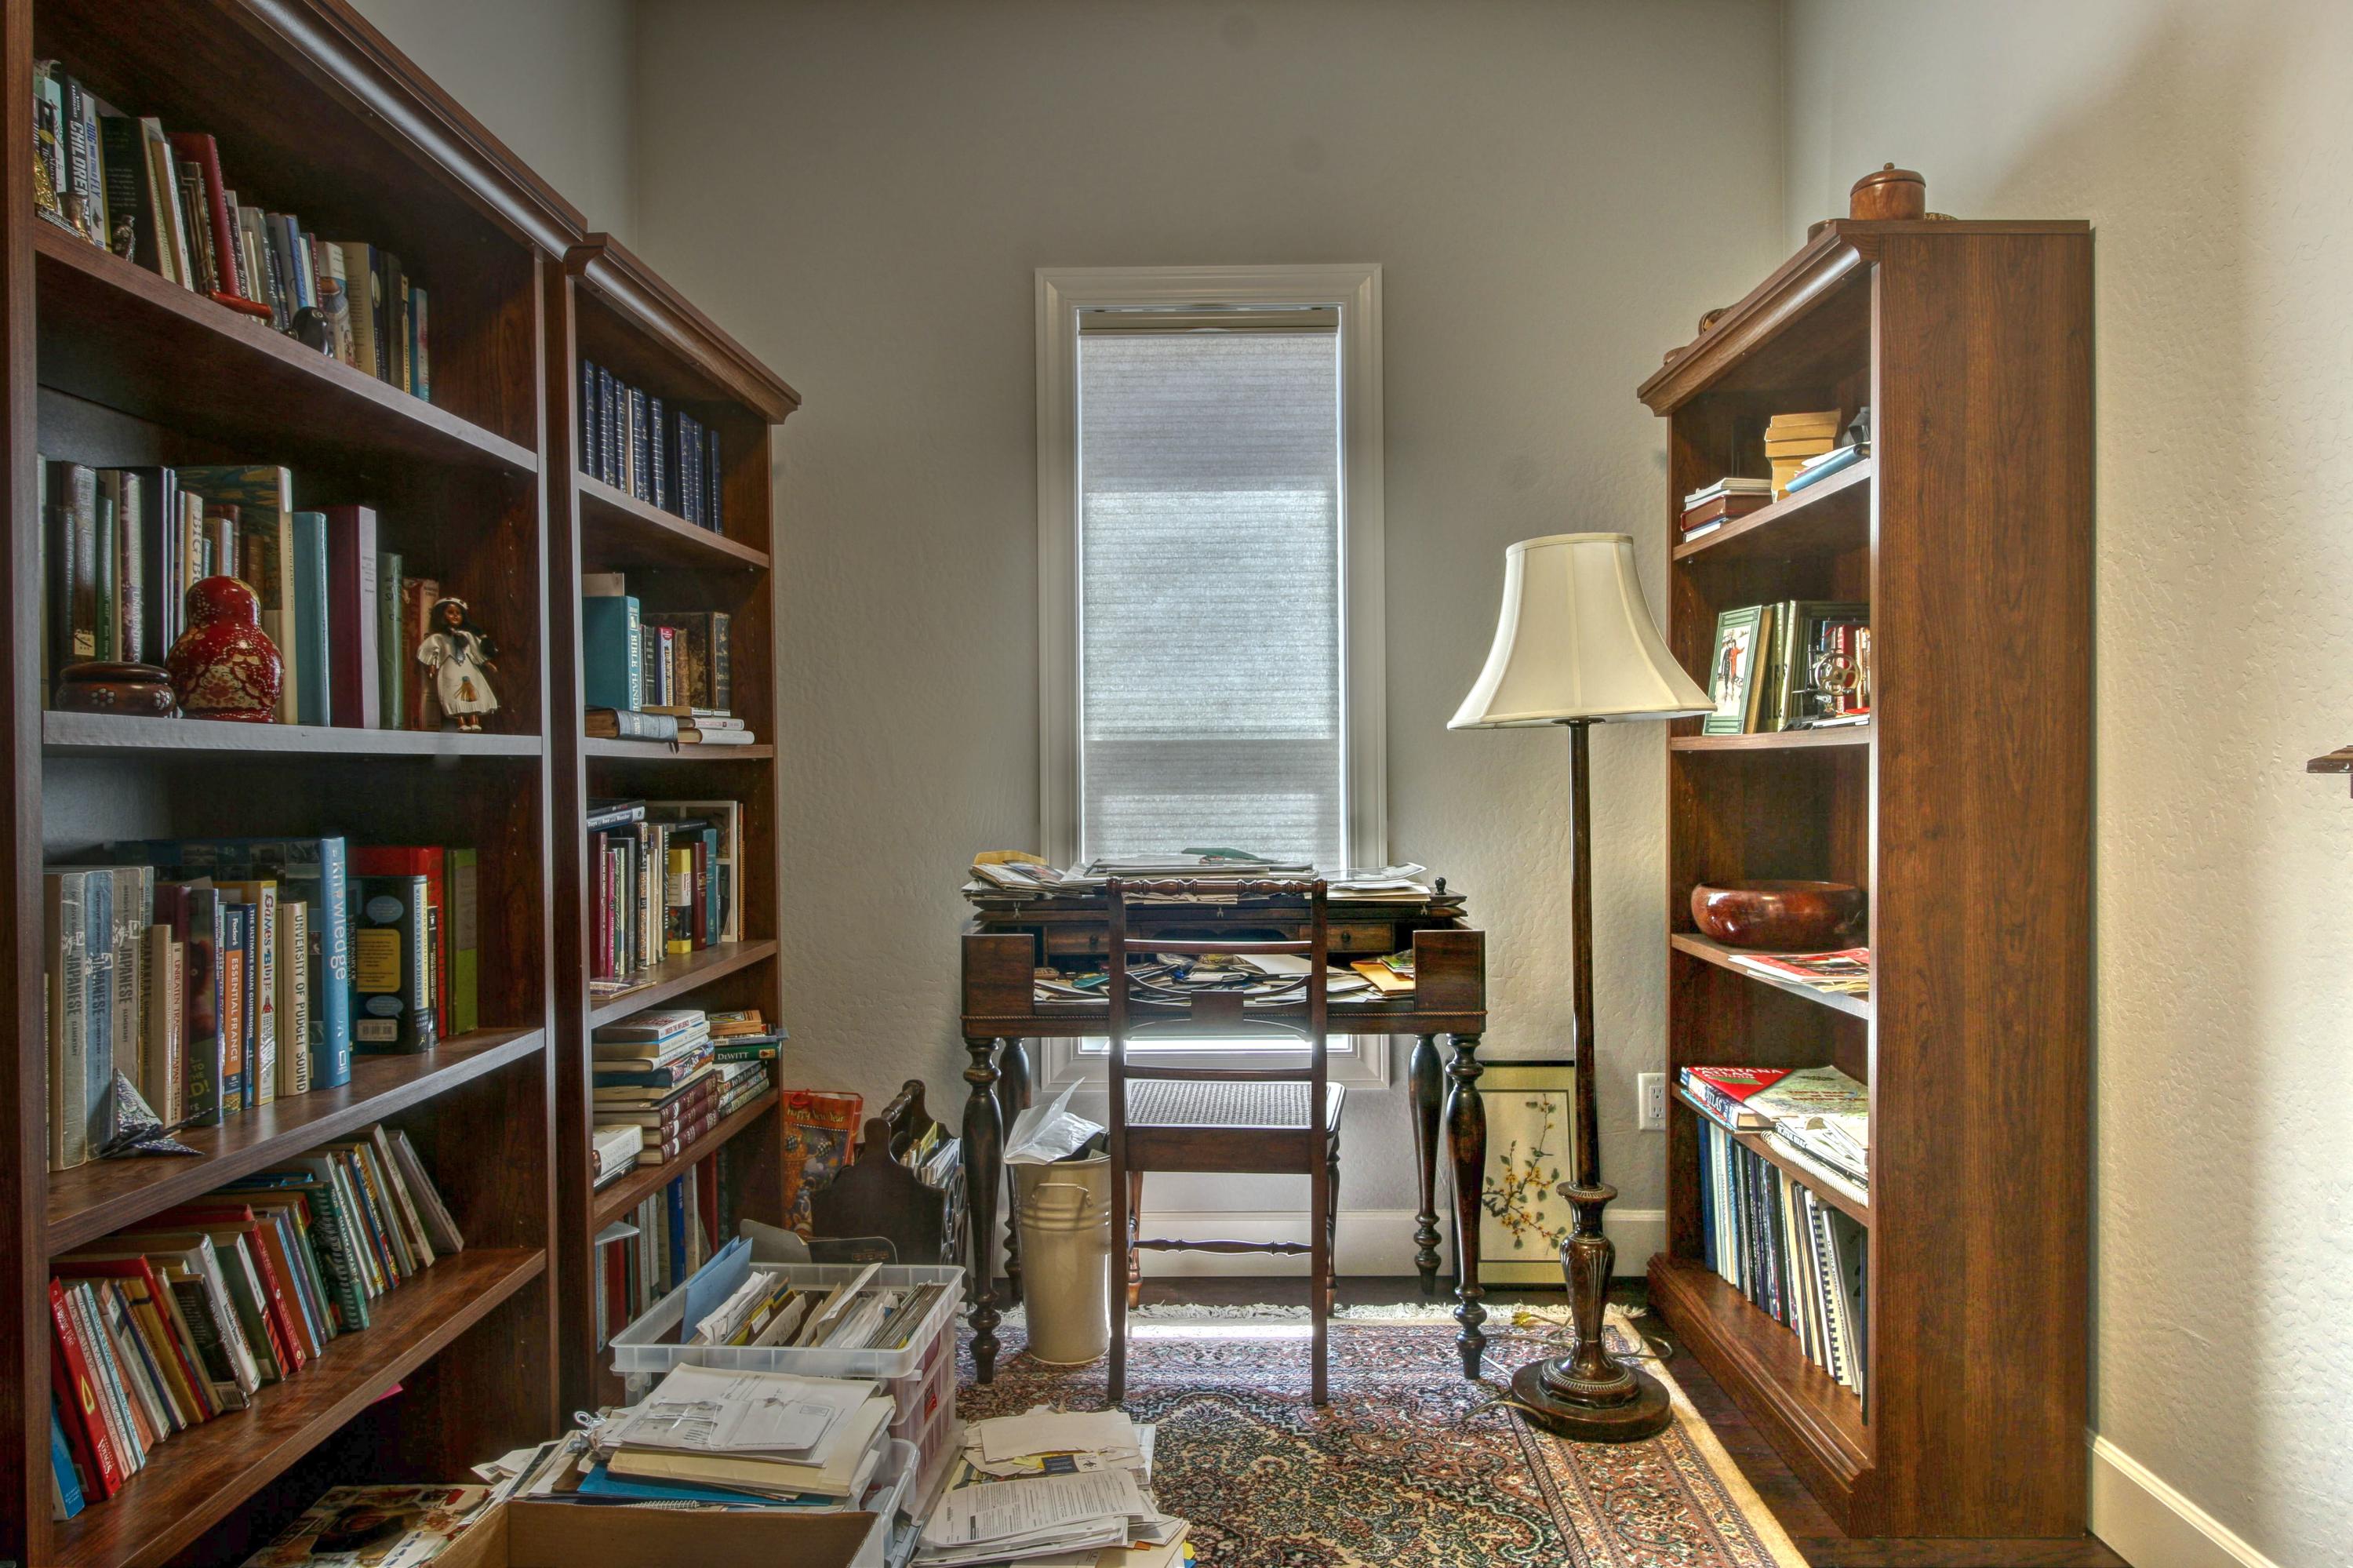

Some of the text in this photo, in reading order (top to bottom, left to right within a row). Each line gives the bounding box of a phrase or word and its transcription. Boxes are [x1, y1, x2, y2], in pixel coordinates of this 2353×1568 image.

[86, 121, 96, 145] DOG
[69, 120, 89, 197] CHILDREN
[89, 176, 101, 199] FLY
[630, 634, 638, 668] BIBLE
[587, 818, 599, 828] Days
[602, 815, 611, 824] Awe
[616, 812, 631, 822] Wonder
[66, 955, 82, 1017] JAPANESE
[118, 945, 133, 1005] JAPANESE
[295, 982, 305, 997] OF
[230, 957, 239, 1062] ESSENTIAL FRANCE
[296, 1051, 307, 1092] SOUND
[787, 1108, 844, 1122] Happy New Year
[54, 1298, 75, 1347] Taming Fire
[102, 1337, 115, 1372] SLIPPERS
[97, 1437, 111, 1475] VOYAGES
